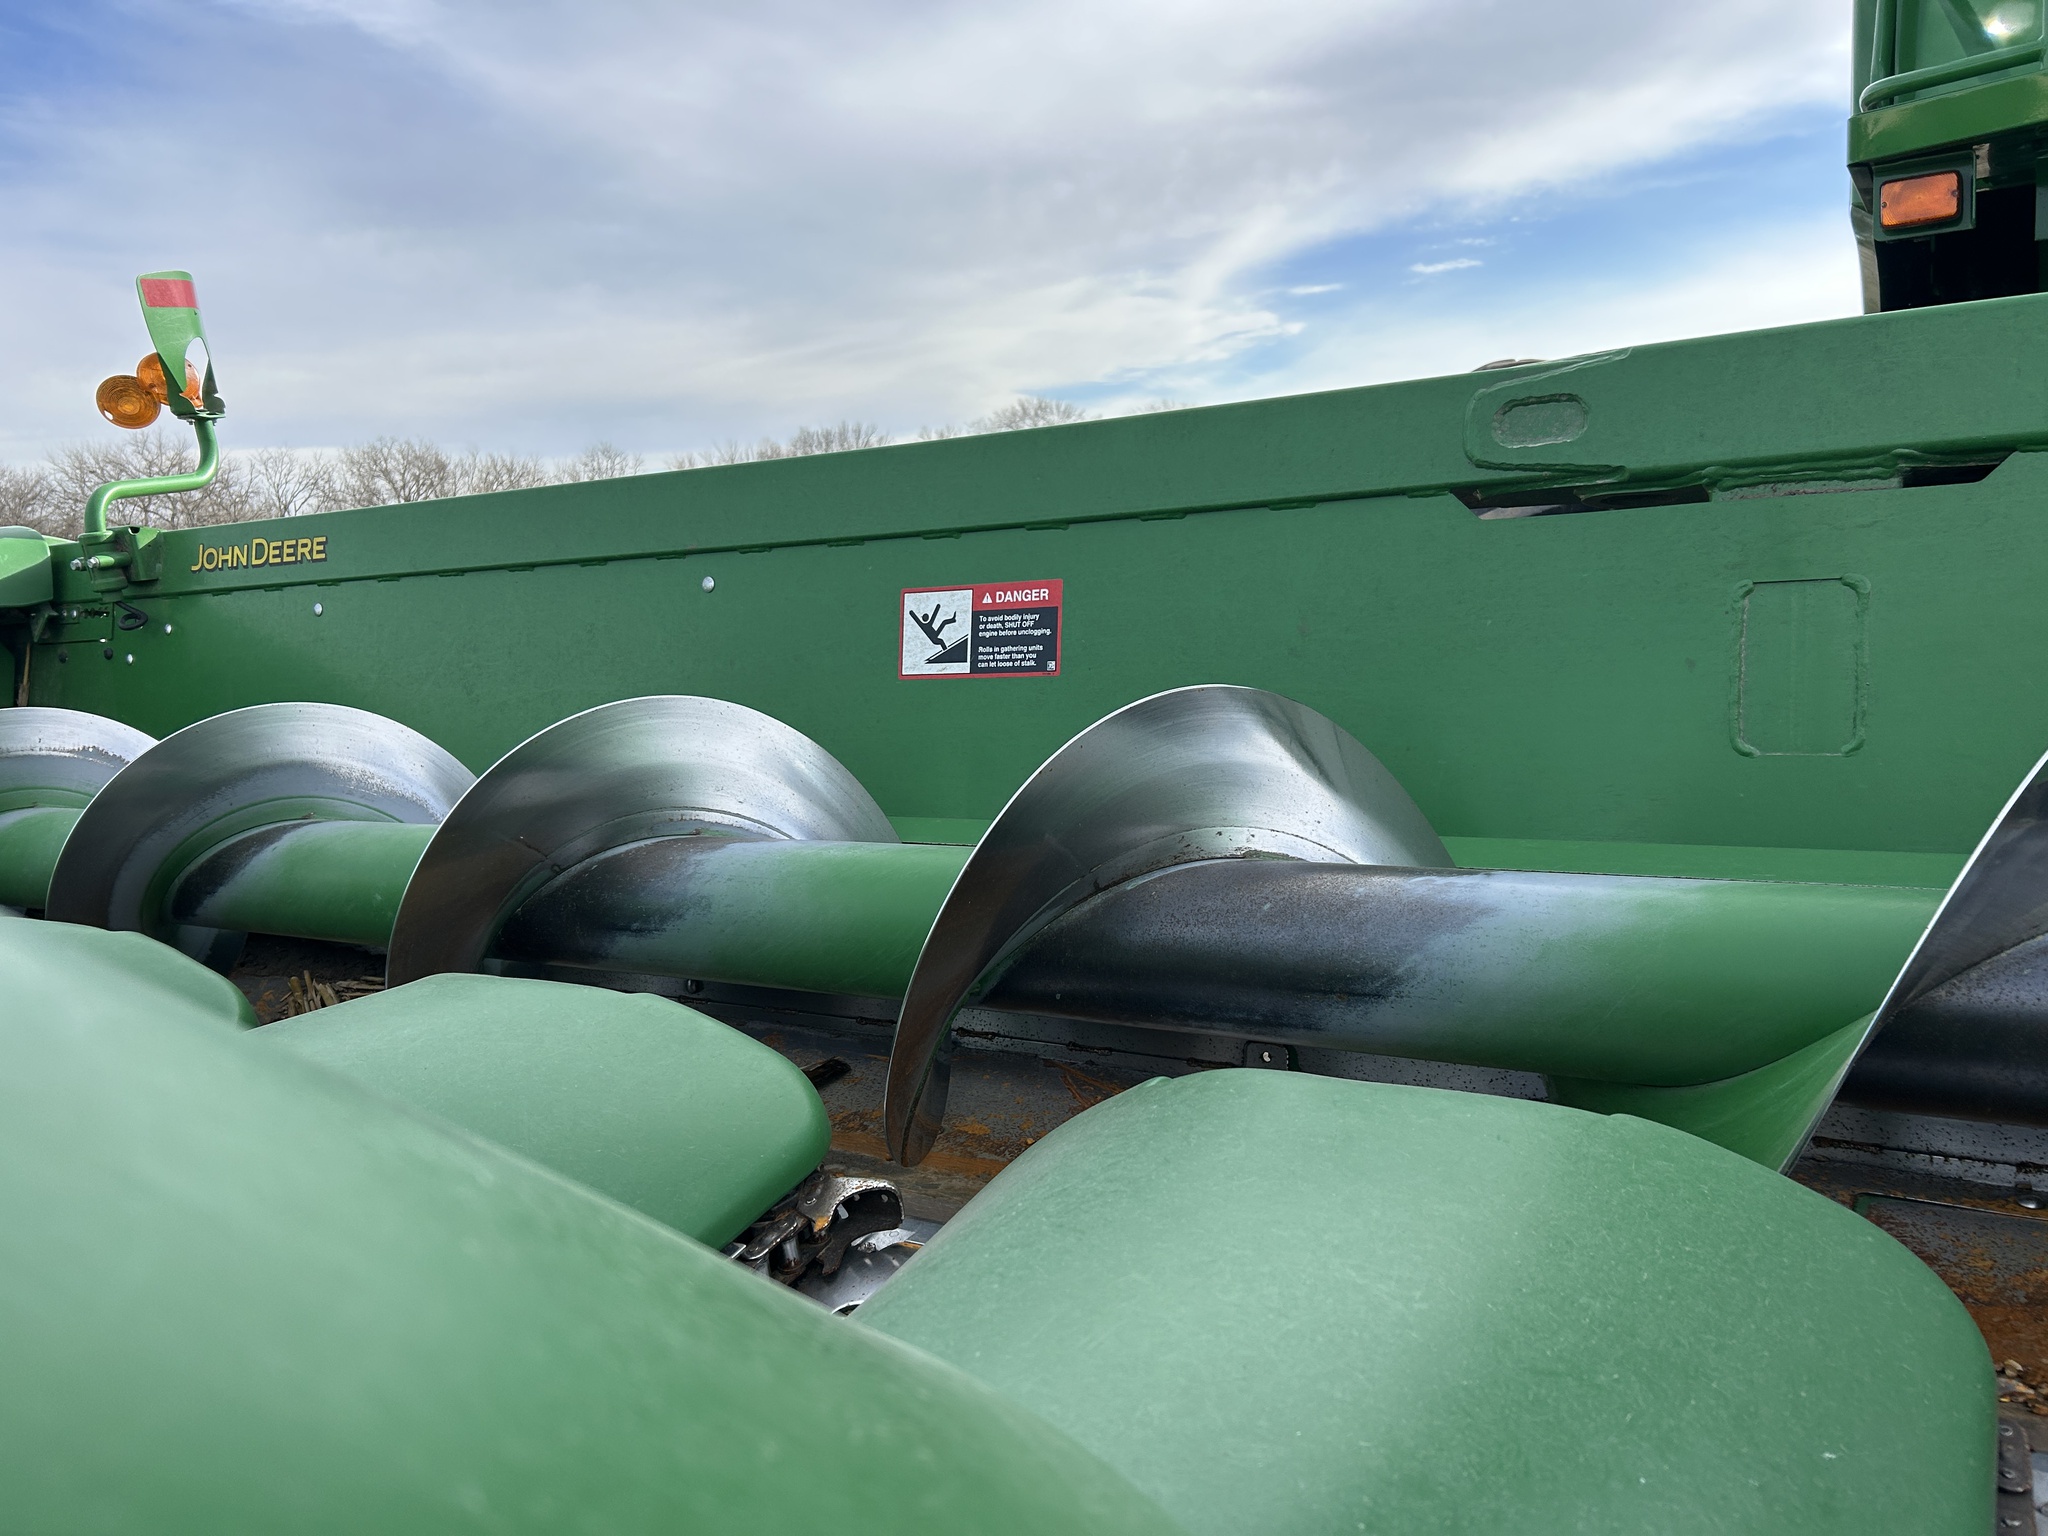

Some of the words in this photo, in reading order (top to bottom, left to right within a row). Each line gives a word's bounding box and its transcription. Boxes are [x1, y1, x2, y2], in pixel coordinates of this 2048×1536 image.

[191, 543, 248, 572] JOHN
[251, 537, 327, 568] DEERE
[996, 588, 1049, 602] DANGER
[1004, 613, 1022, 621] bodily
[1023, 613, 1040, 621] injury
[978, 630, 997, 638] engine
[1017, 628, 1052, 636] unclogging.
[1000, 645, 1027, 653] gathering
